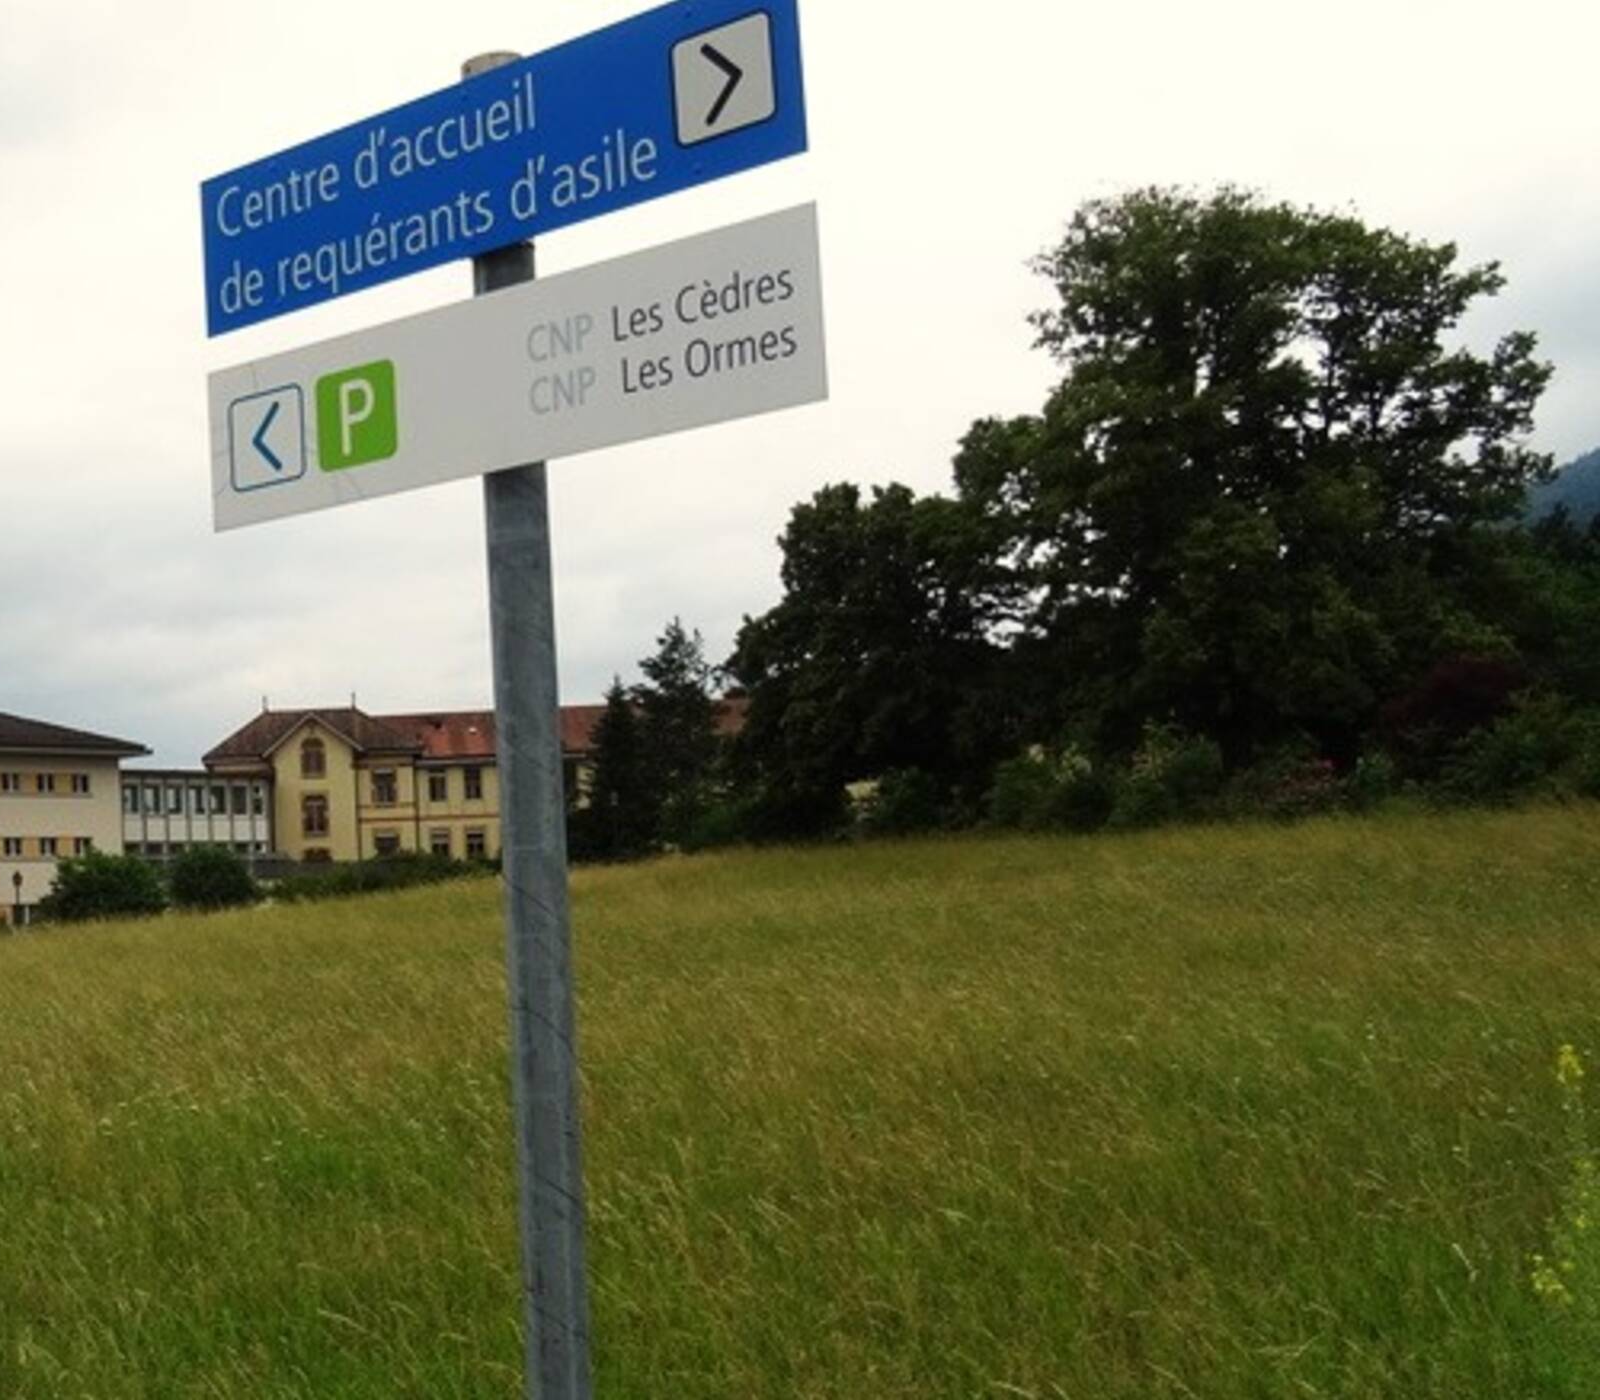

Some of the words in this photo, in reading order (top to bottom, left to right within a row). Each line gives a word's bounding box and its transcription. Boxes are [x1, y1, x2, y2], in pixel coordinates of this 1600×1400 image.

[217, 164, 339, 237] Centre
[354, 72, 537, 188] d'accueil
[221, 260, 264, 314] de
[278, 190, 494, 297] requérants
[510, 129, 657, 219] d'asile
[527, 313, 594, 362] CNP
[611, 301, 663, 342] Les
[675, 268, 794, 323] Cèdres
[530, 366, 596, 415] CNP
[622, 353, 673, 394] Les
[685, 323, 797, 379] Ormes
[341, 379, 374, 456] P
